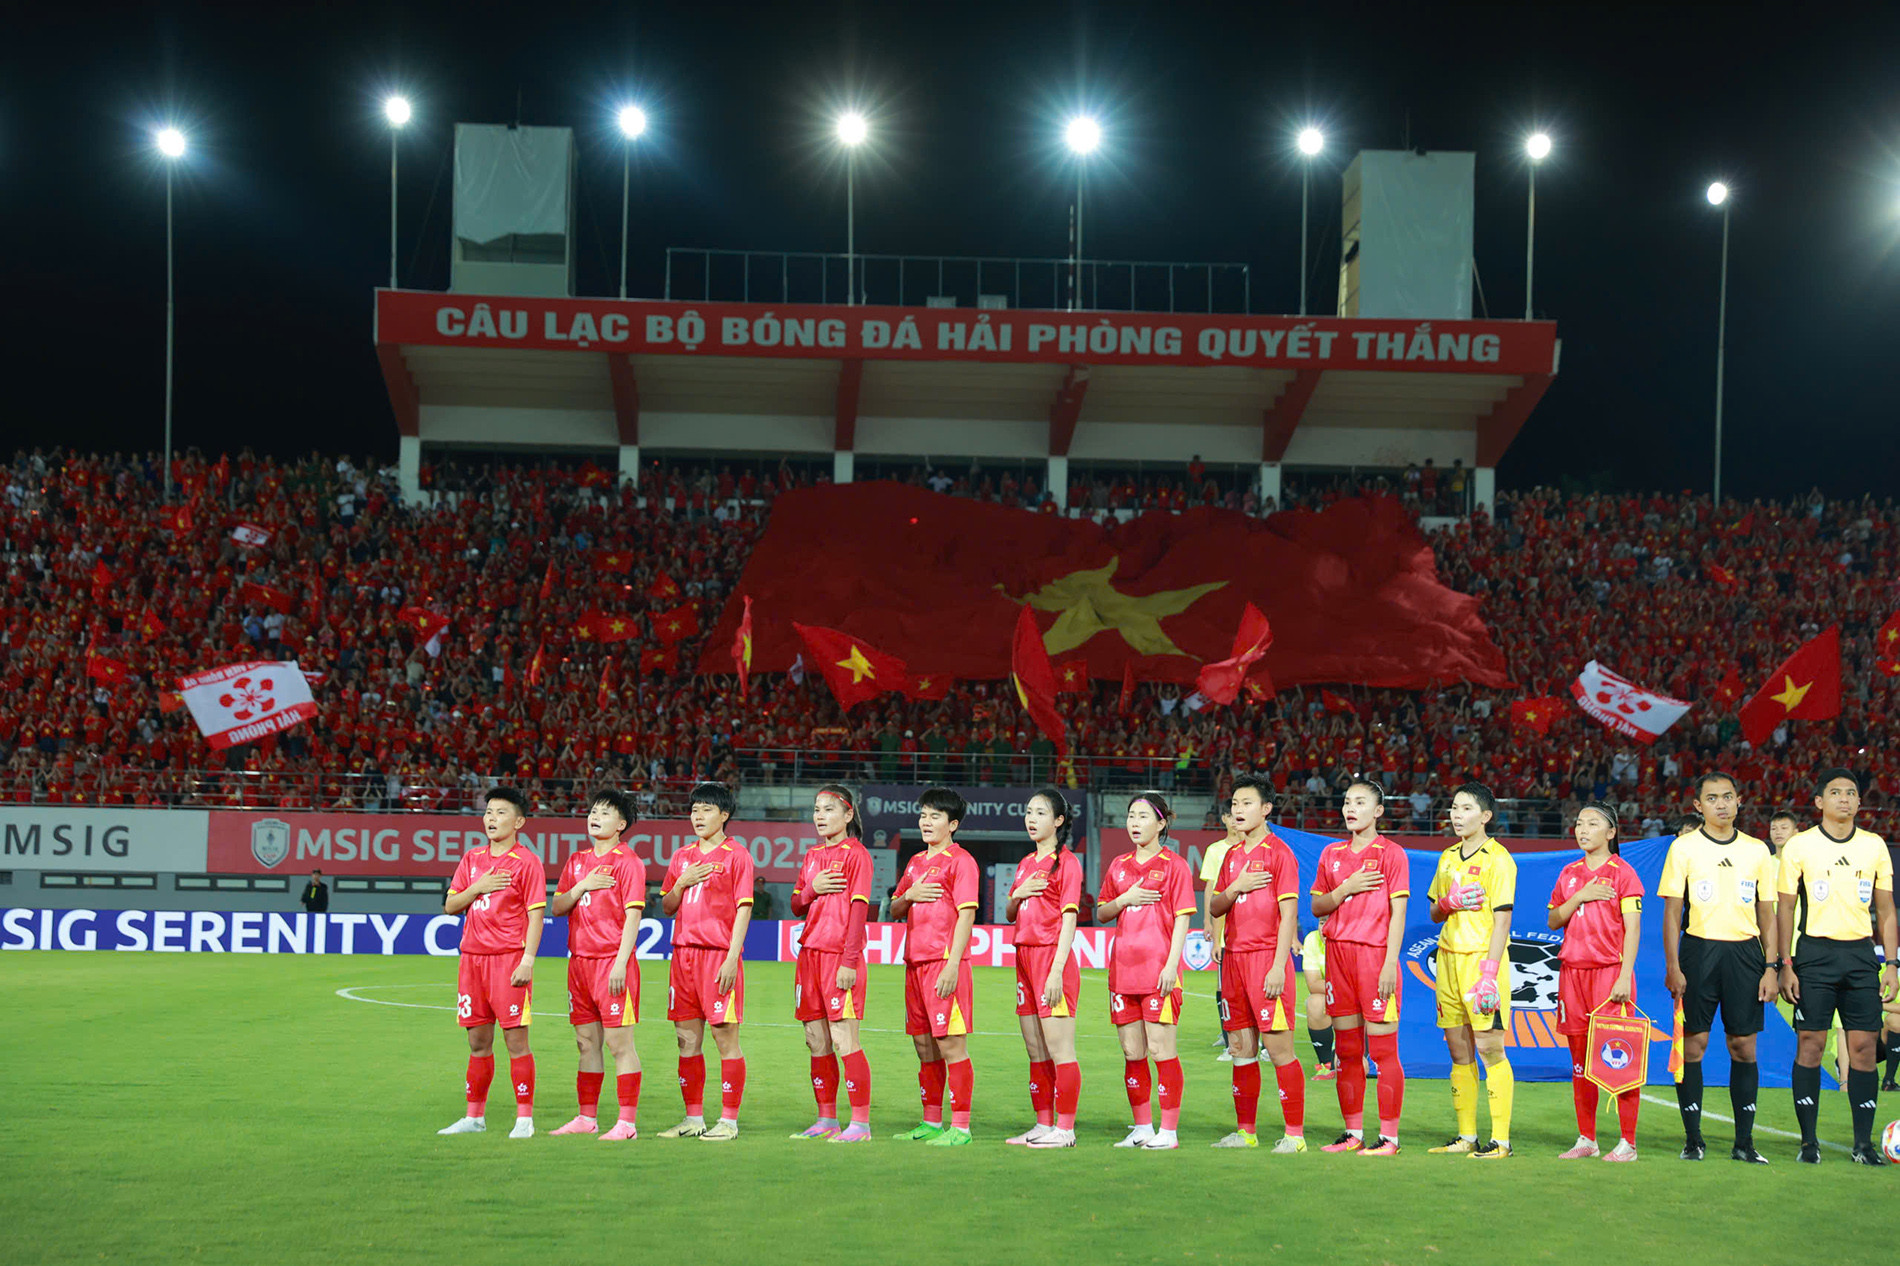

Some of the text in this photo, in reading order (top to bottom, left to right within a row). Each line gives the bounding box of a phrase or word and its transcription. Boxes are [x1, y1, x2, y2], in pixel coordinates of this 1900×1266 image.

[436, 303, 1500, 362] CÂU LẠC BỘ BÓNG ĐÁ HẢI PHÒNG QUYẾT THẮNG
[4, 824, 130, 857] MSIG
[296, 828, 401, 862] MSIG
[115, 909, 409, 956] SERENITY
[1406, 936, 1439, 959] ASEAN
